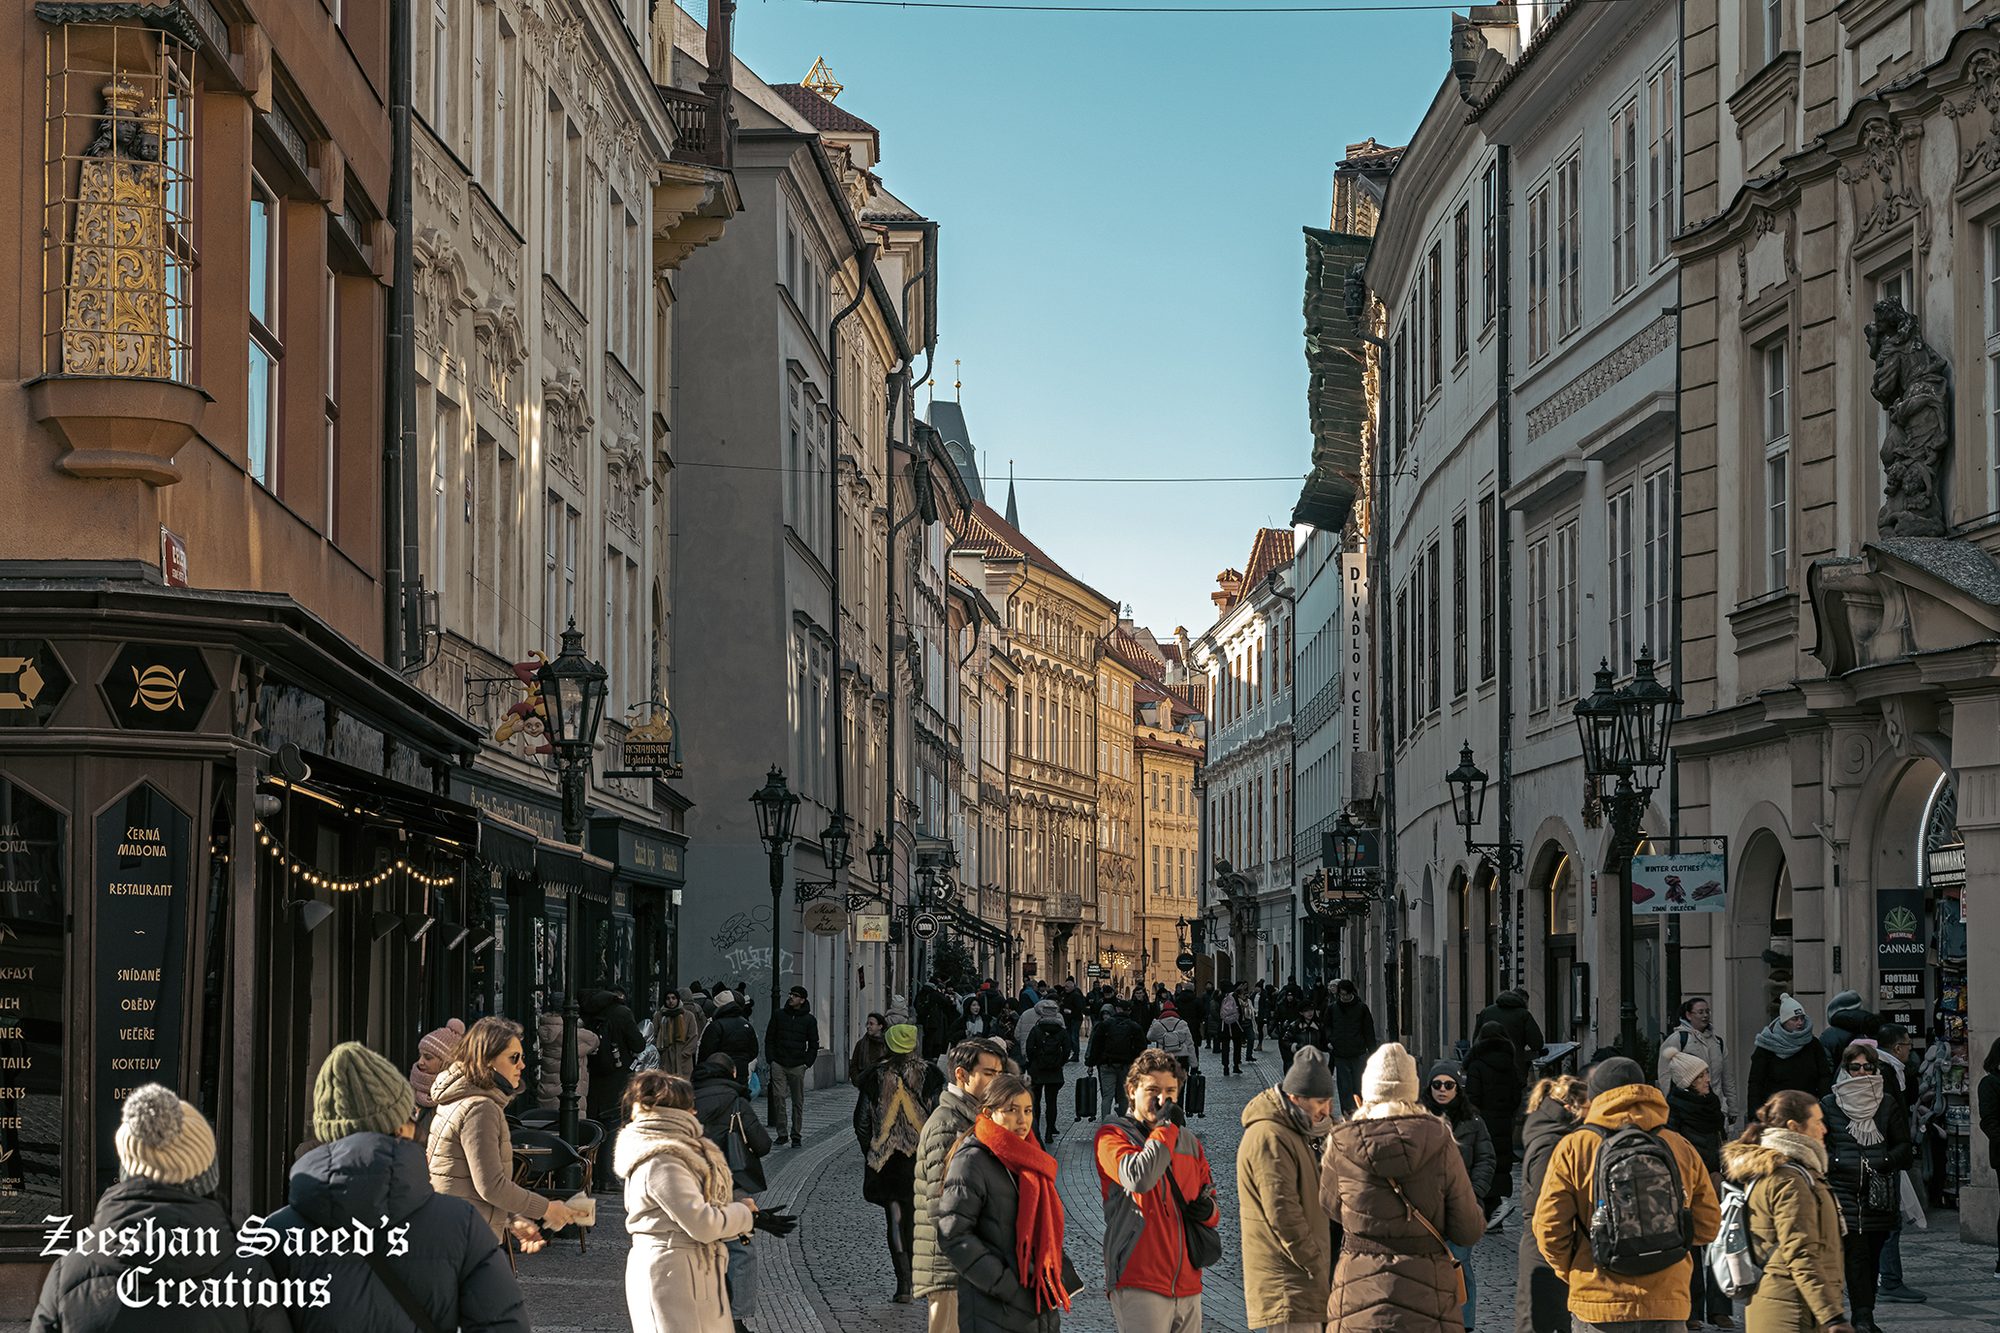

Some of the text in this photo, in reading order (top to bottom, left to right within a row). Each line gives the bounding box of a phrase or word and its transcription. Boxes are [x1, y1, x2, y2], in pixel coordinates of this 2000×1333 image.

[1350, 567, 1361, 664] DIVADLO
[0, 822, 20, 836] NÁ
[126, 826, 160, 840] ČERNÁ
[117, 844, 167, 857] MADONA
[109, 882, 173, 896] RESTAURANT
[1879, 943, 1925, 954] CANNABIS
[117, 968, 161, 981] SNÍDANĚ
[1885, 974, 1919, 983] FOOTBALL
[1893, 985, 1916, 994] -SHIRT
[121, 998, 155, 1011] OBĚDY
[1895, 1014, 1910, 1023] BAG
[120, 1027, 155, 1041] VEČEŘE
[112, 1058, 161, 1070] KOKTEJLY
